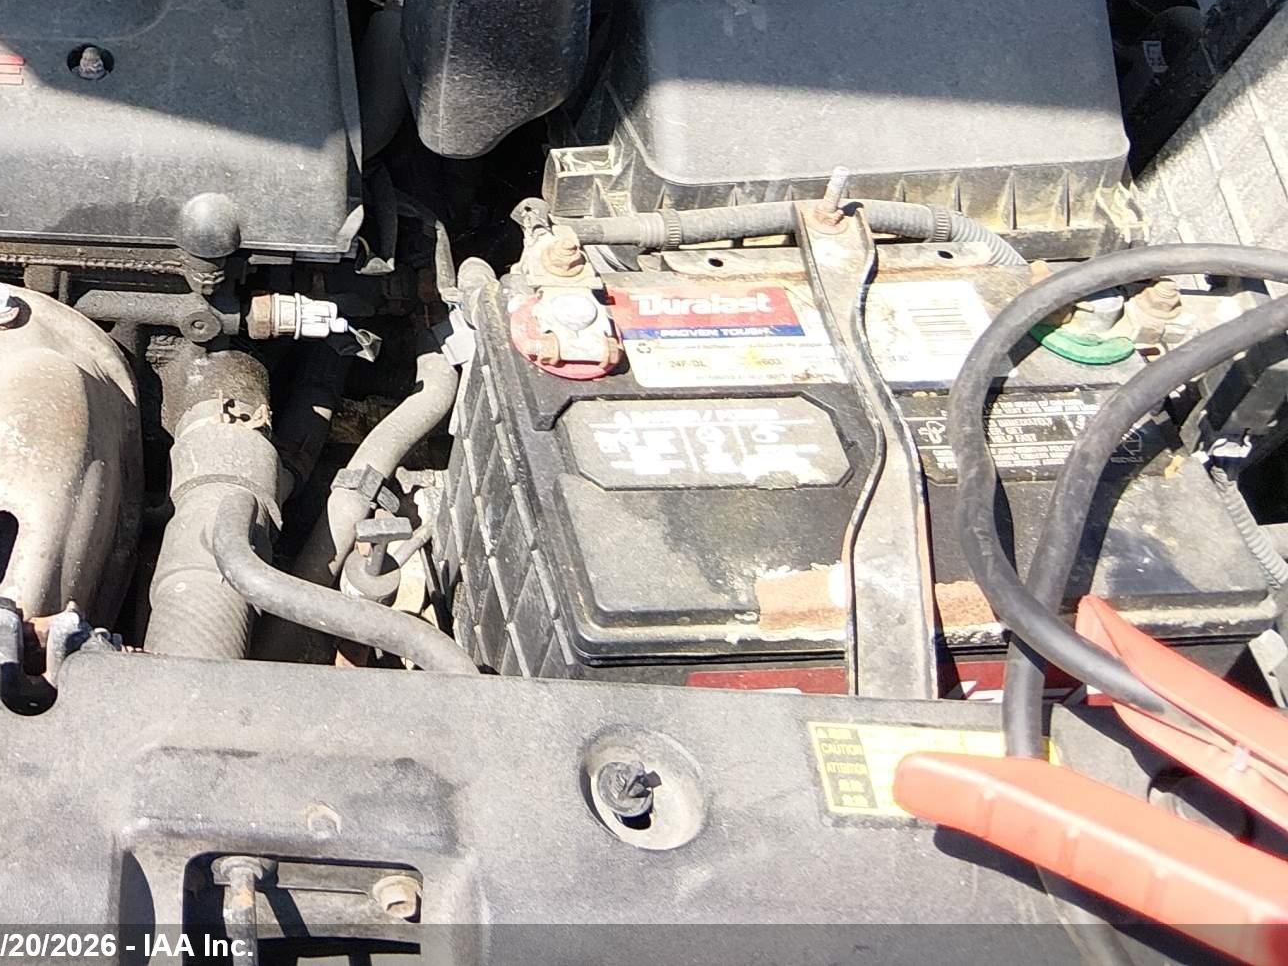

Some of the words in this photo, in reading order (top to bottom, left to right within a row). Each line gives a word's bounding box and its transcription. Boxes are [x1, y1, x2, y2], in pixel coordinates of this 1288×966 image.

[629, 291, 772, 317] Duralast
[659, 328, 718, 339] PROVEN
[821, 742, 864, 756] CAUTION
